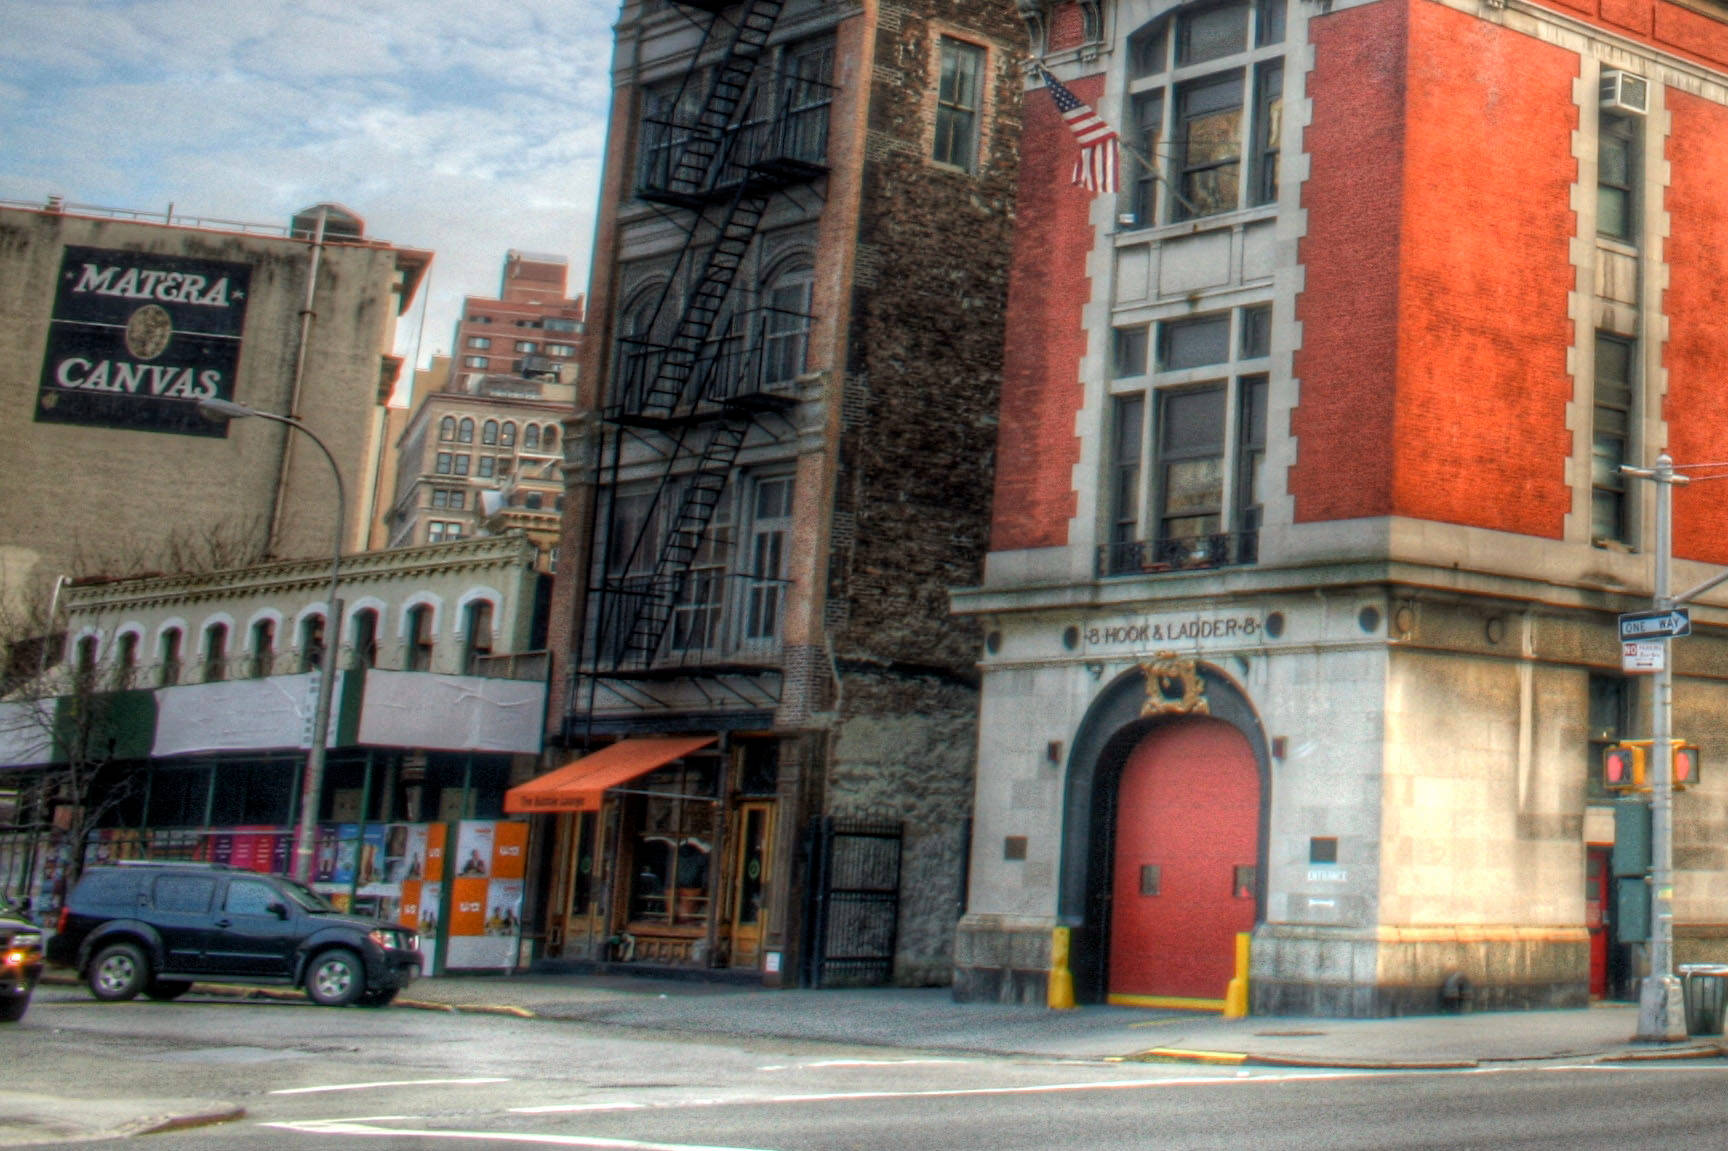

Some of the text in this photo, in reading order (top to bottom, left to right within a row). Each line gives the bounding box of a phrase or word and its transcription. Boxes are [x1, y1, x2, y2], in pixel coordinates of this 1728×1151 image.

[73, 263, 230, 307] MATERA
[56, 357, 221, 399] CANVAS
[1105, 625, 1150, 644] HOOK
[1152, 625, 1163, 641] &
[1167, 618, 1237, 641] LADDER
[1625, 617, 1680, 633] ONE WAY
